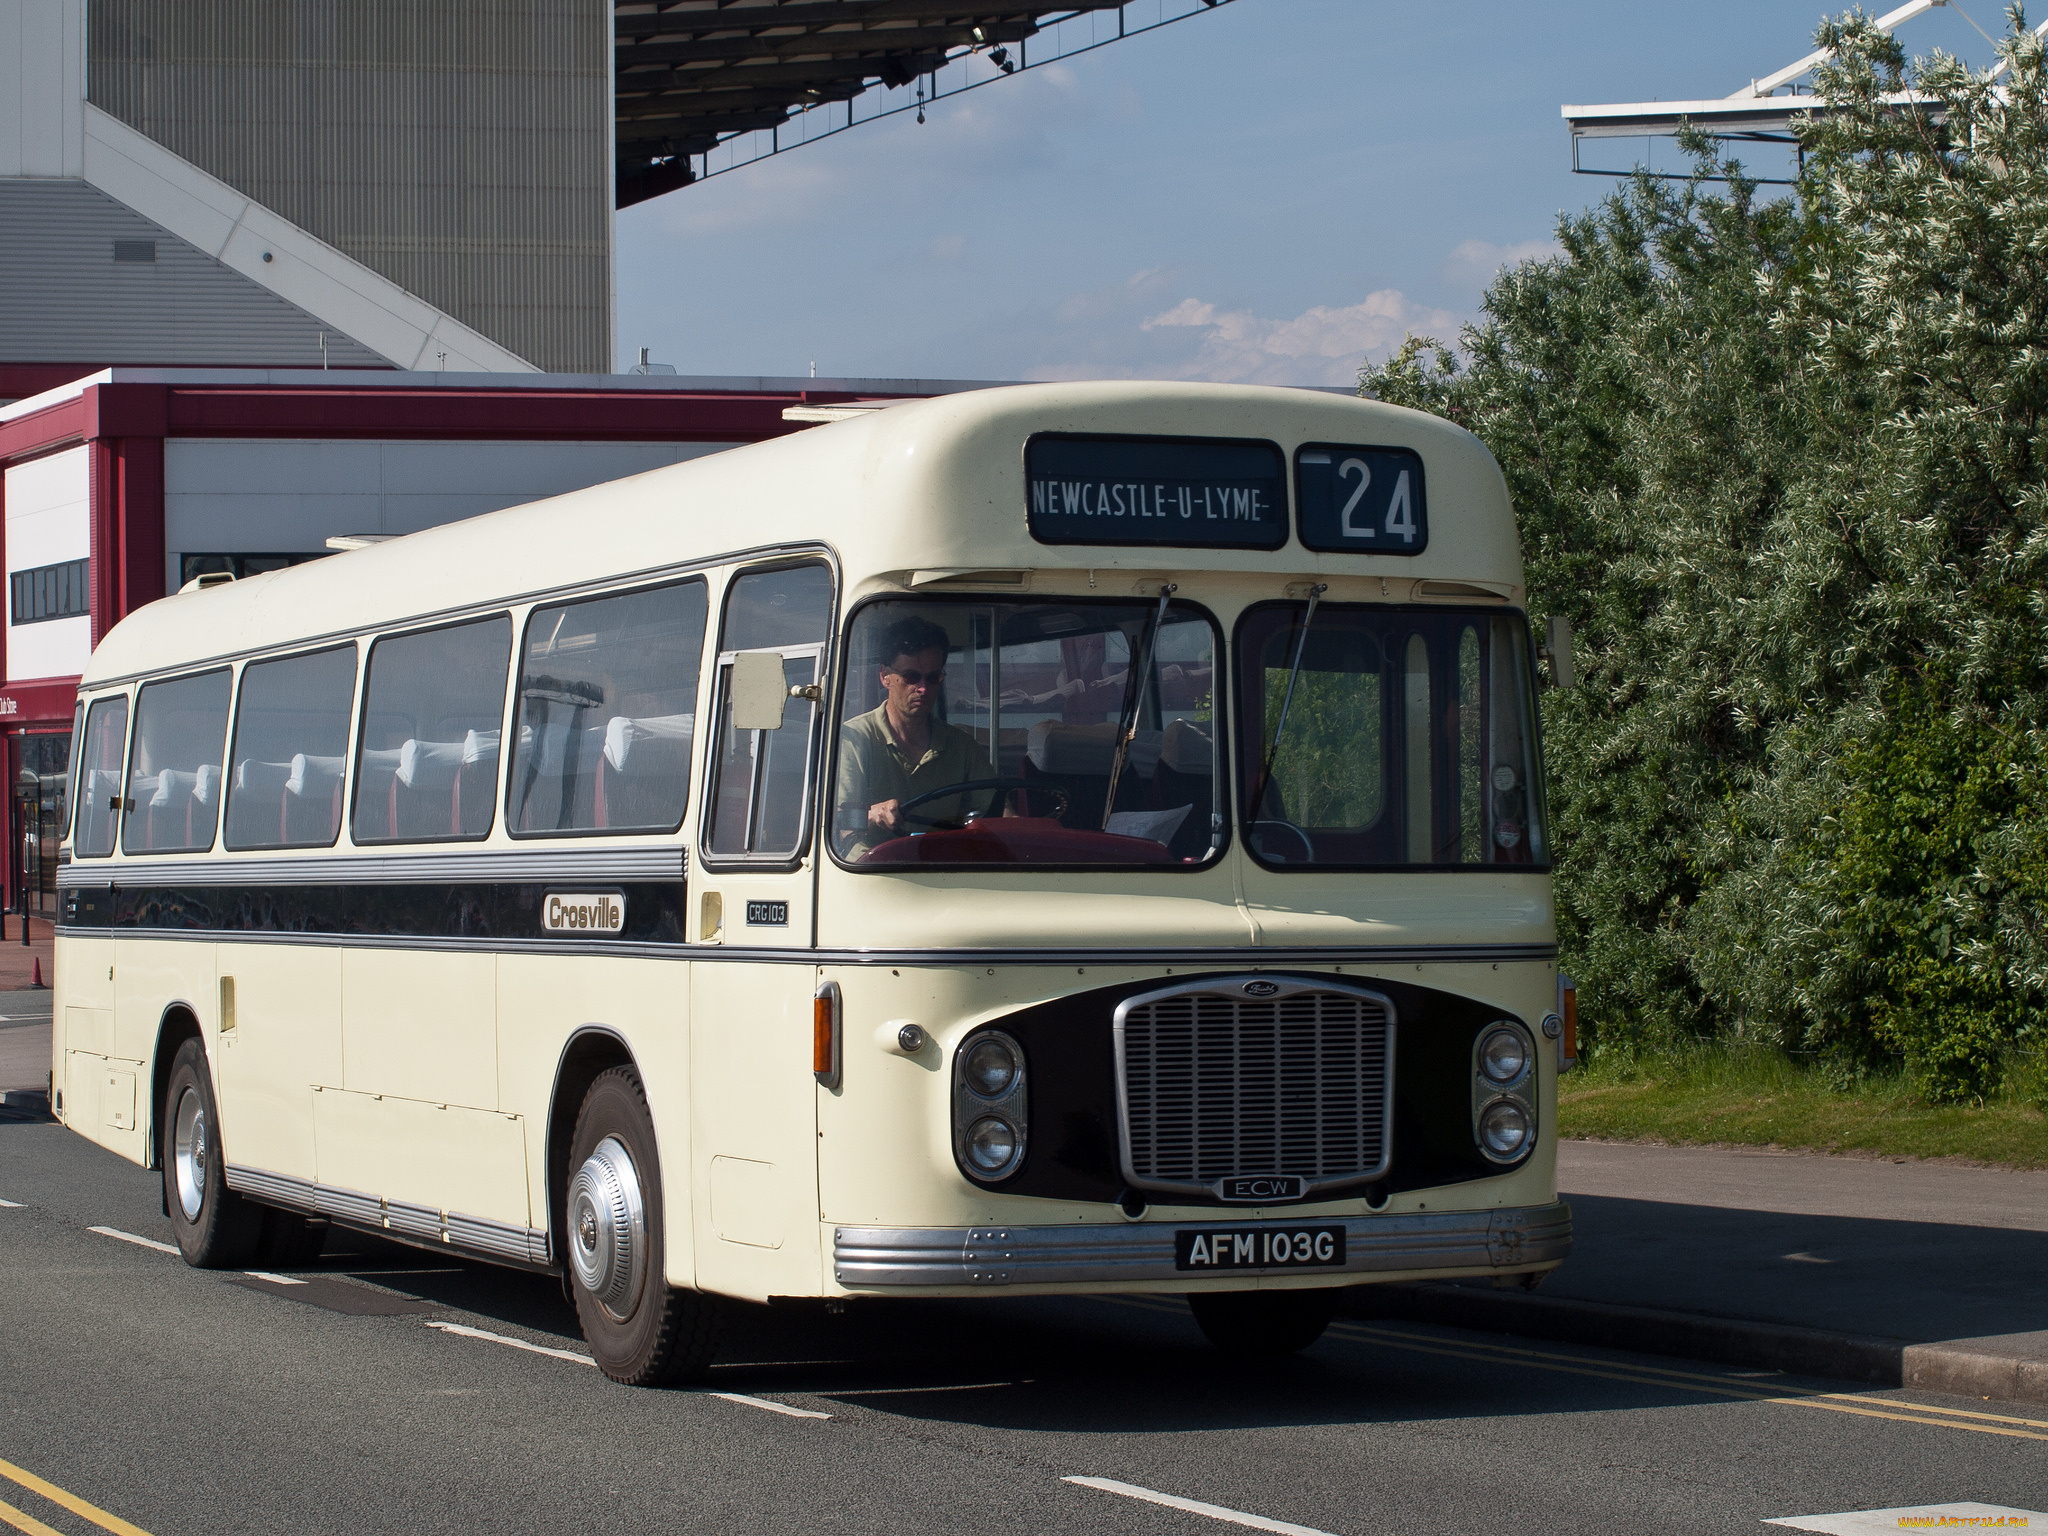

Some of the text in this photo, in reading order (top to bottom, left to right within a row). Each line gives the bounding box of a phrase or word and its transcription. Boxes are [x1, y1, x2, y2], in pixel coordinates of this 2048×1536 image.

[1338, 457, 1417, 544] 24
[549, 897, 620, 929] Crosville
[1235, 1180, 1287, 1196] ECW
[1190, 1231, 1335, 1265] AFM 103G
